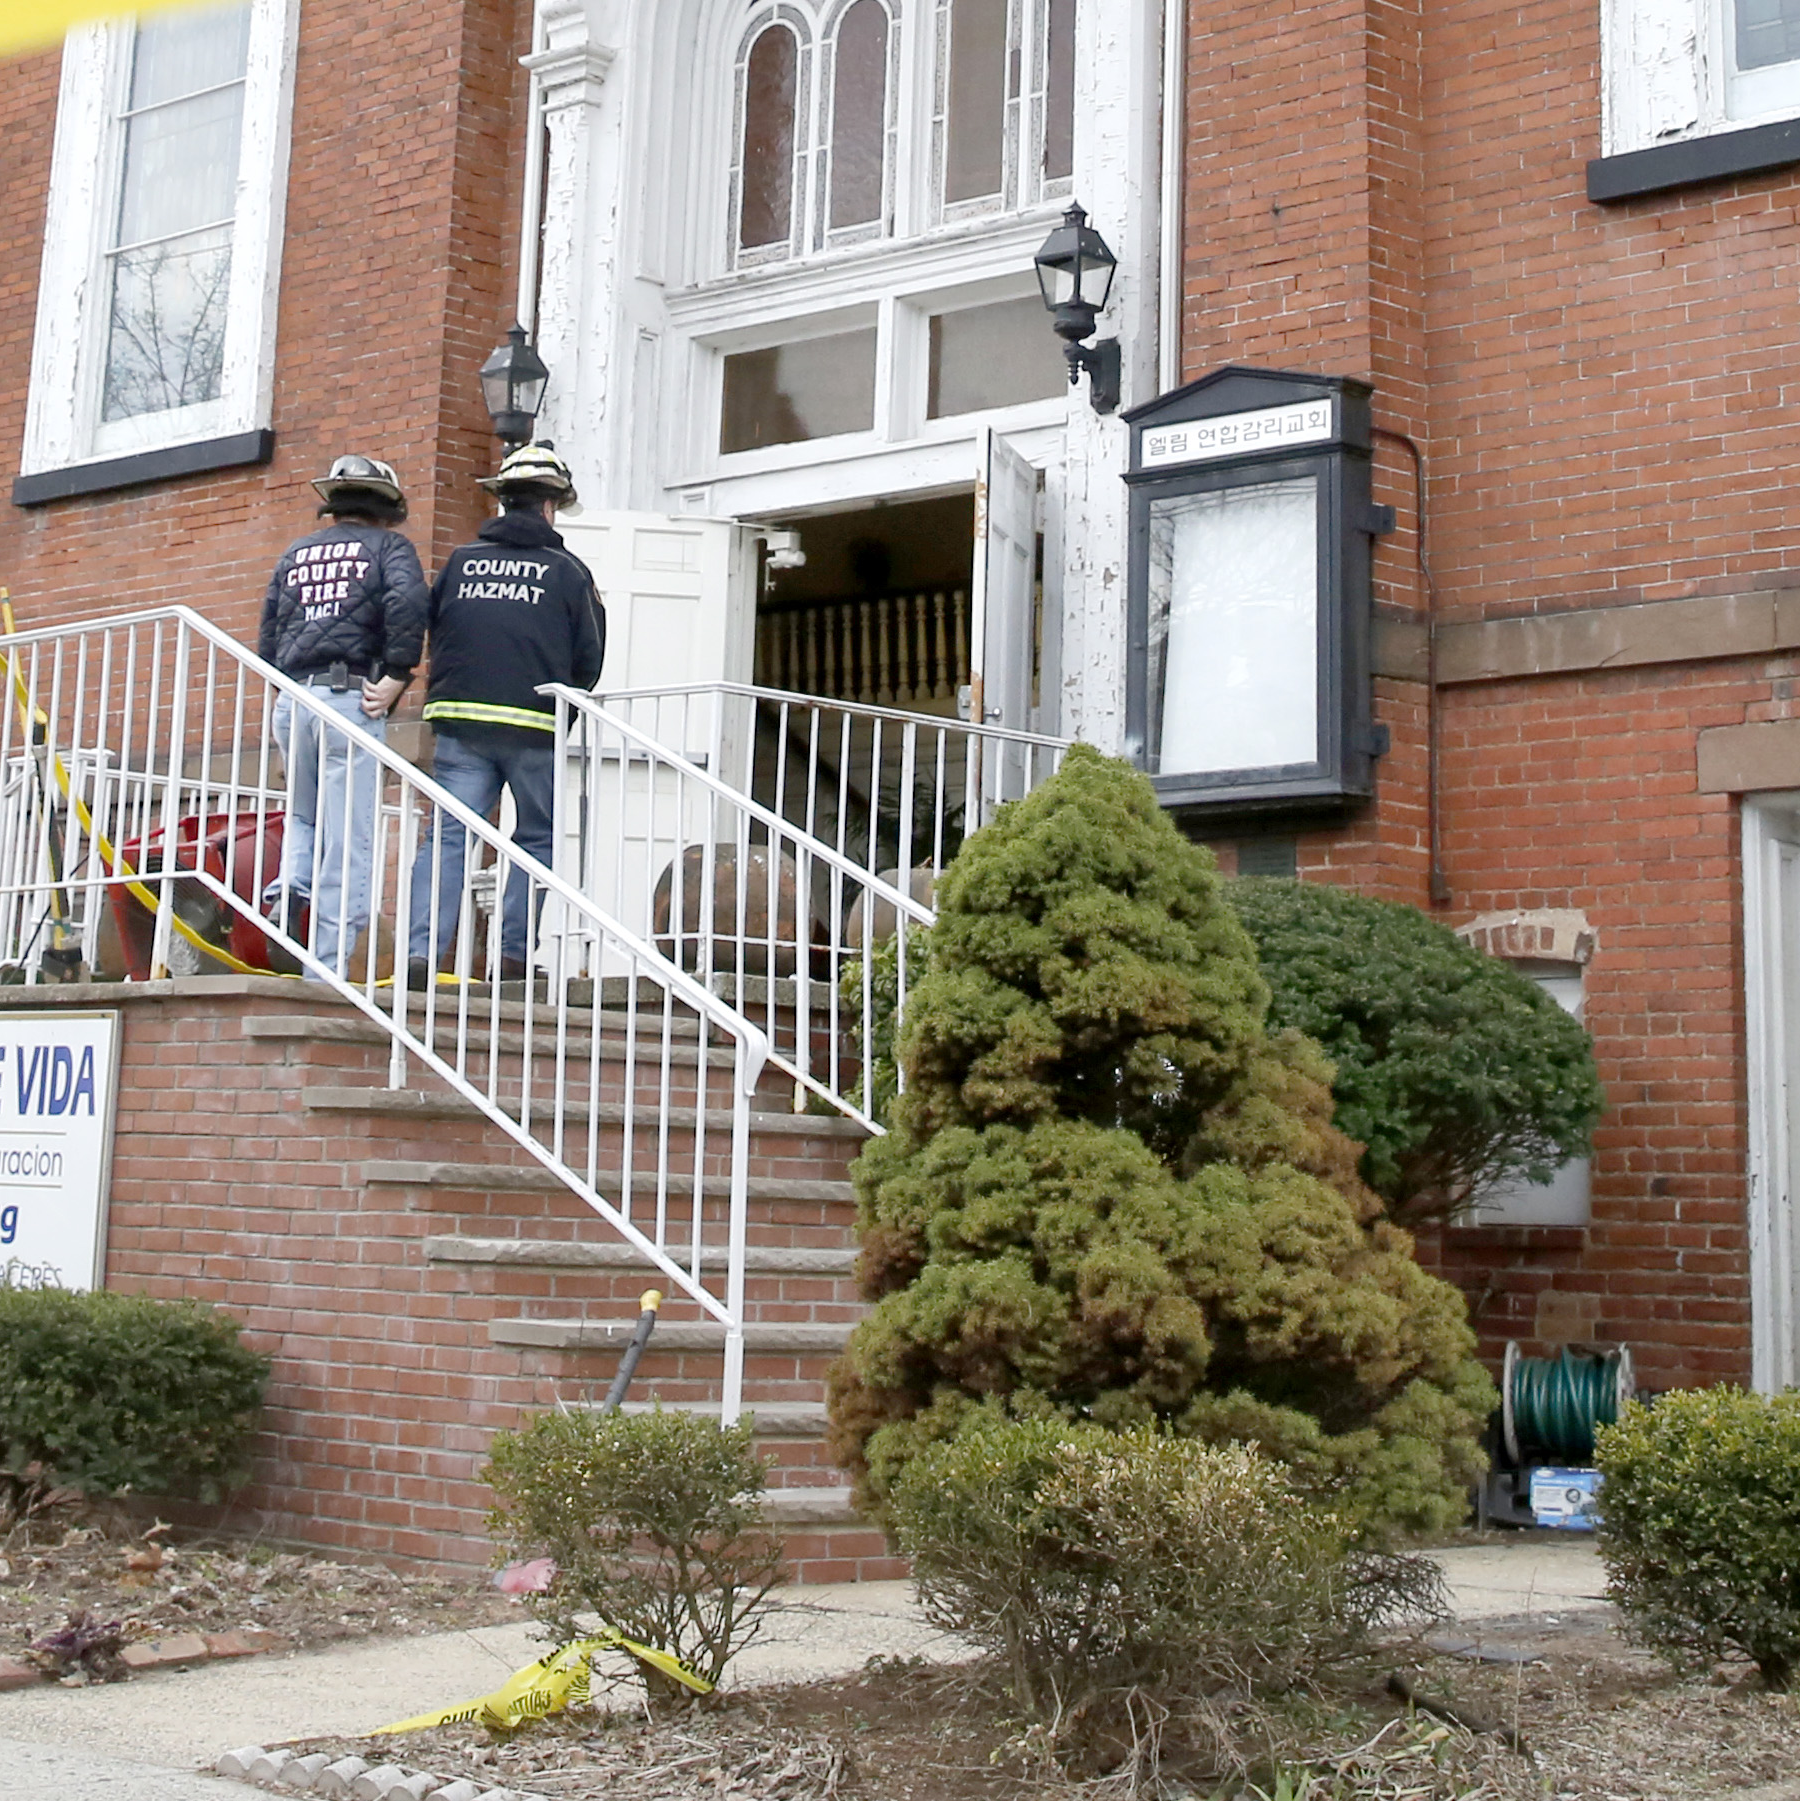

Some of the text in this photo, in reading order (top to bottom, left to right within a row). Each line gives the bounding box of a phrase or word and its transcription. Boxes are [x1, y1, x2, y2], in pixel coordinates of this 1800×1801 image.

[1149, 409, 1327, 456] 엘림 연합감리교회
[295, 542, 362, 564] UNION
[287, 560, 370, 587] COUNTY
[462, 559, 550, 580] COUNTY
[301, 581, 349, 604] FIRE
[457, 582, 545, 605] HAZMAT
[305, 602, 332, 622] MAC
[16, 1045, 95, 1116] VIDA
